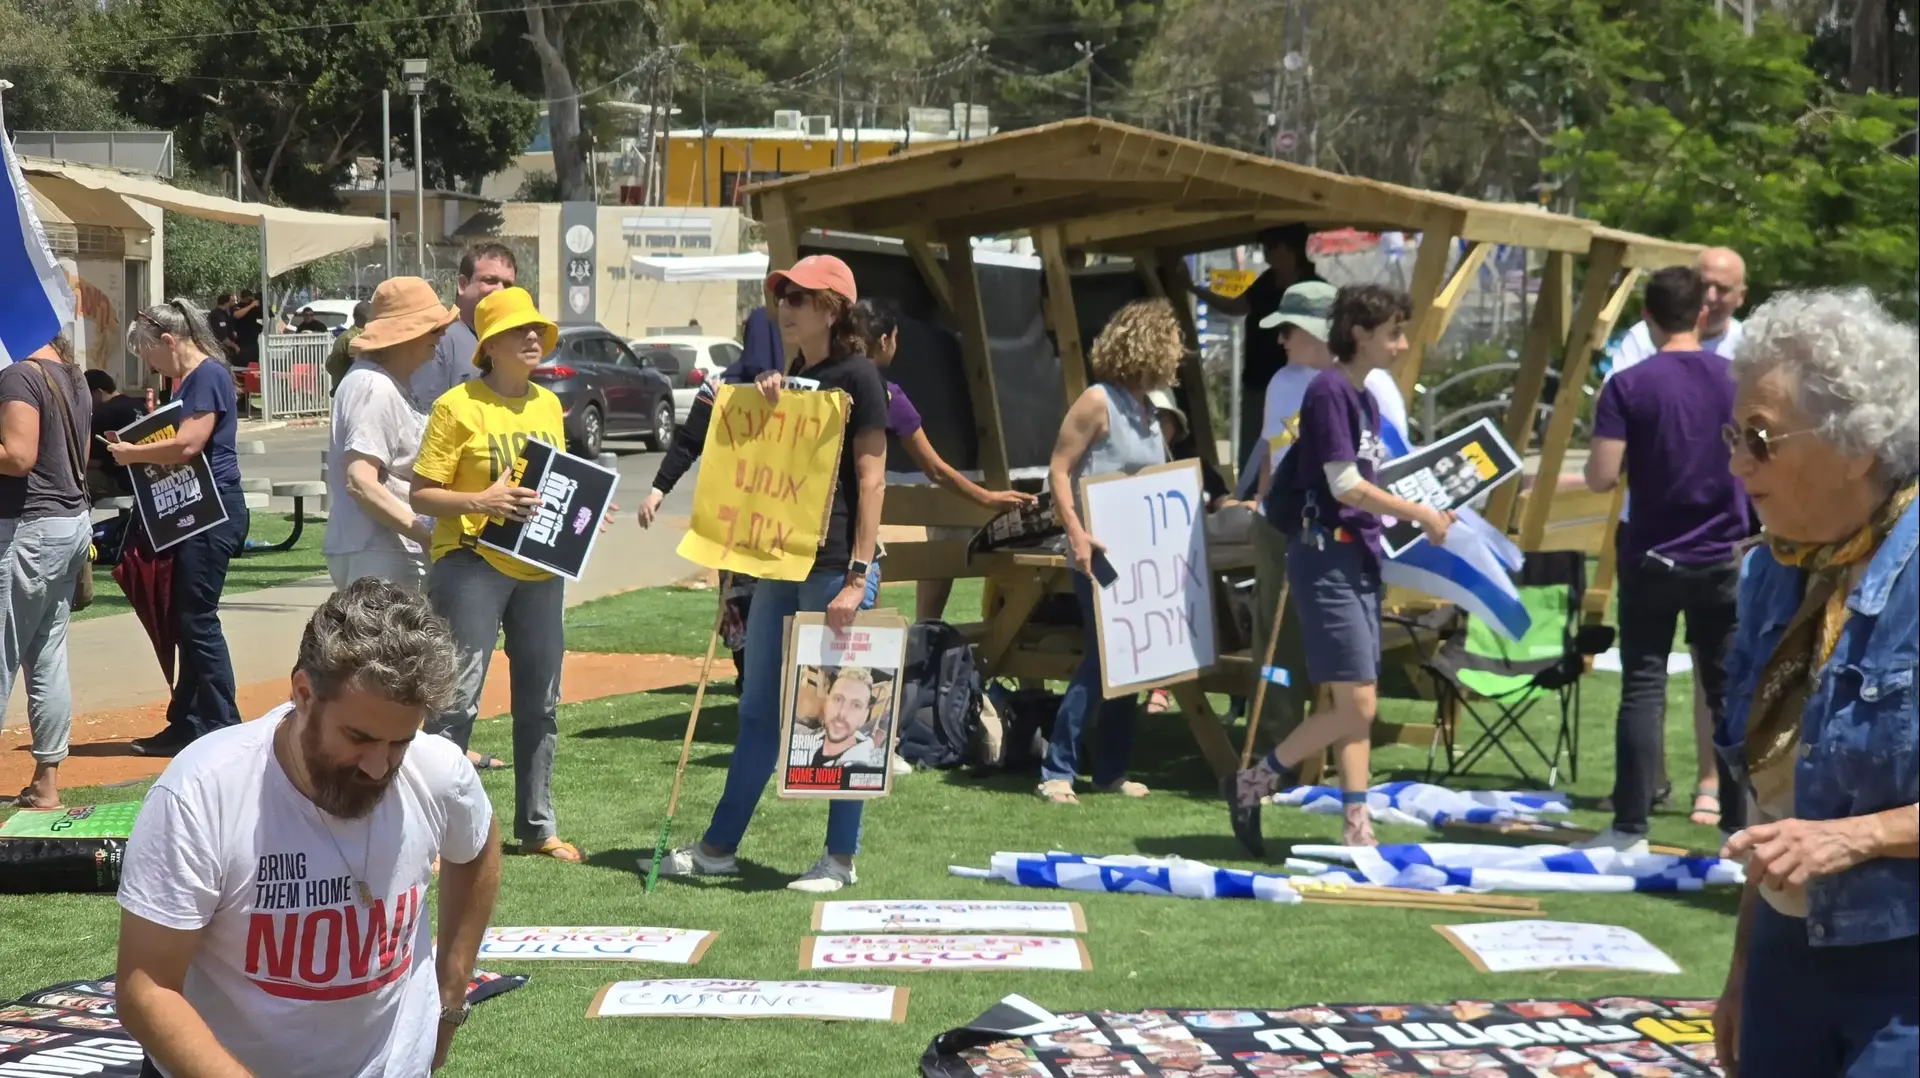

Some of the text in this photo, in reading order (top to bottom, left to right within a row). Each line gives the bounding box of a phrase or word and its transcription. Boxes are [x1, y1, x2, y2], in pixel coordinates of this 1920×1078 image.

[150, 465, 196, 497] למלחמה
[153, 478, 201, 513] שלהם
[735, 458, 808, 505] אנחנו
[526, 471, 571, 545] שלהם
[1143, 489, 1191, 546] רון
[1112, 602, 1198, 675] איתך
[789, 750, 809, 766] HIM
[791, 734, 822, 750] BRING
[788, 767, 815, 783] HOME
[815, 766, 842, 783] NOW!
[257, 852, 307, 882] BRING
[254, 875, 352, 909] THEM HOME
[245, 884, 418, 984] NOW!
[1253, 1025, 1376, 1054] עד
